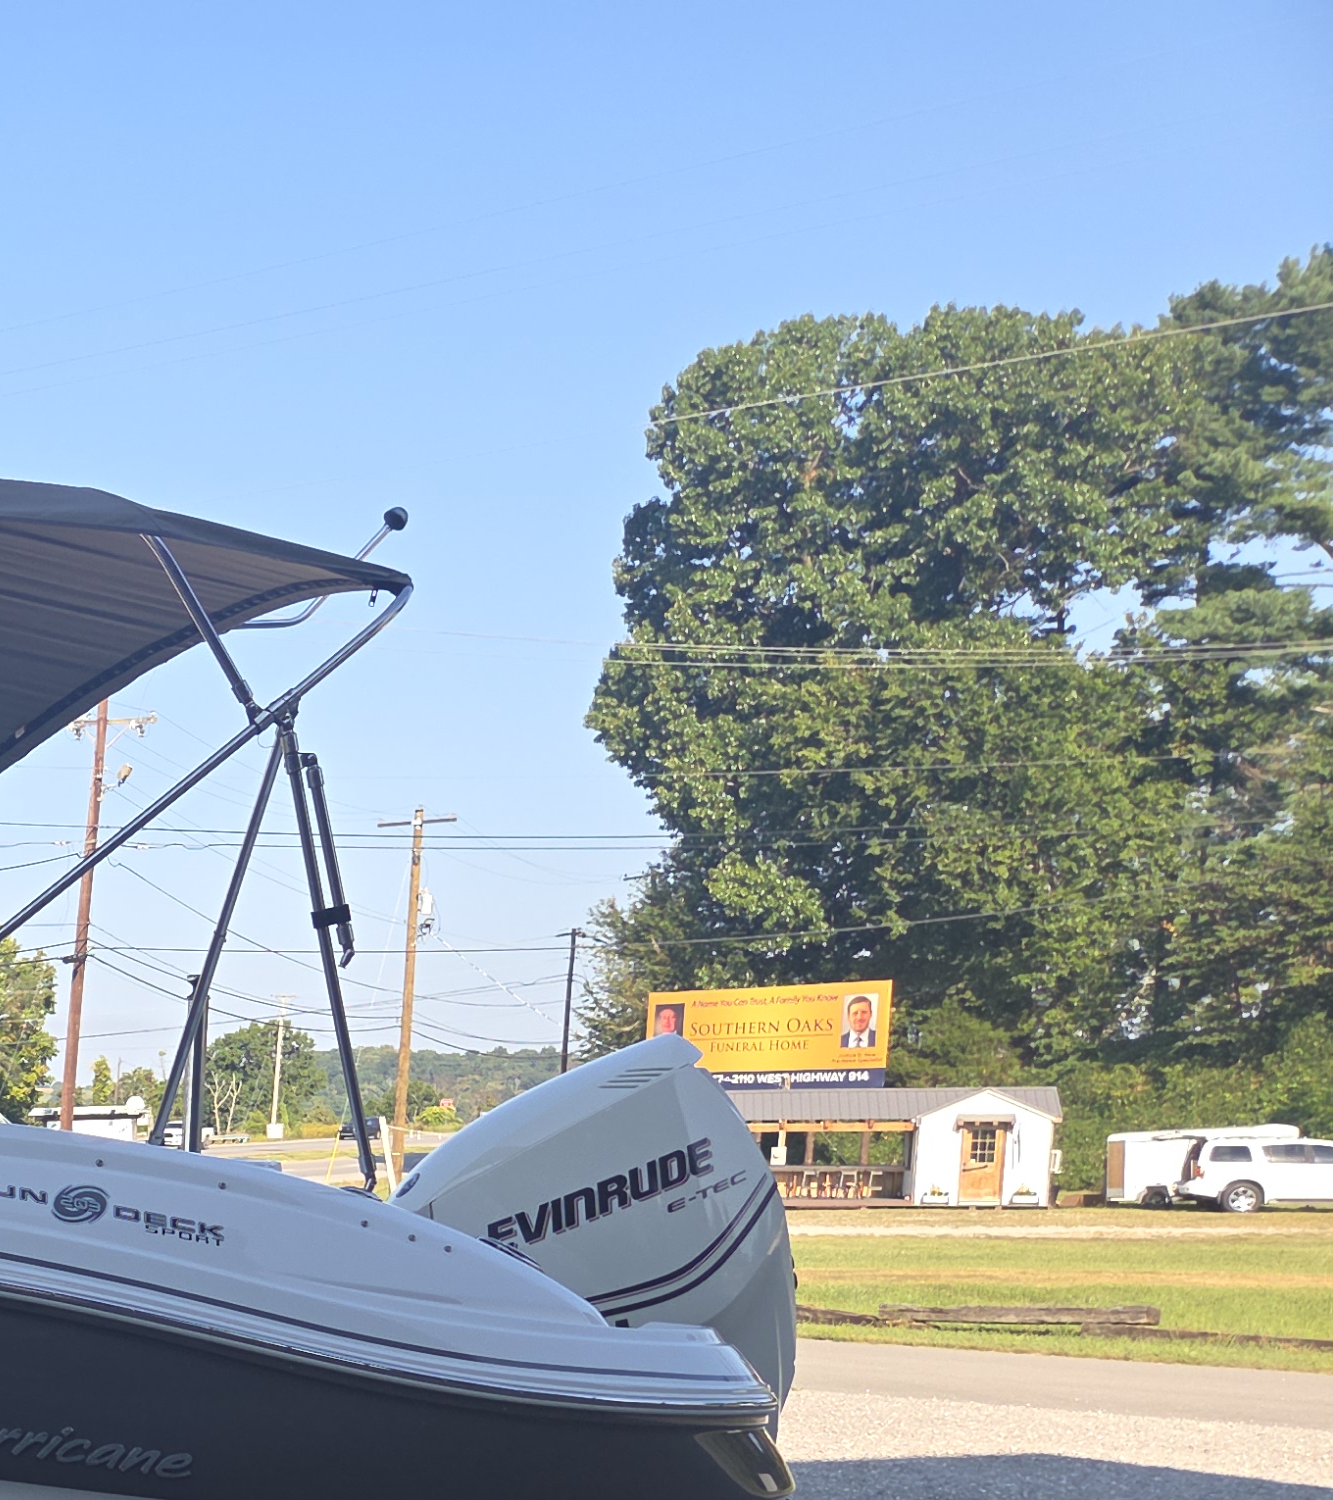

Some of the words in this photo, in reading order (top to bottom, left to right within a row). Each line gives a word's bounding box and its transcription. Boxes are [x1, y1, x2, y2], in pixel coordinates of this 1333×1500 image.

[802, 994, 815, 1002] You
[689, 1020, 780, 1037] SOUTHERN
[786, 1017, 834, 1033] OAKS
[710, 1040, 764, 1053] FUNERAL
[769, 1038, 810, 1052] HOME
[790, 1071, 846, 1083] HIGHWAY
[487, 1137, 714, 1249] EVINRUDE
[667, 1170, 747, 1213] E-TEC
[113, 1204, 225, 1241] DECK
[144, 1222, 225, 1247] SPORT
